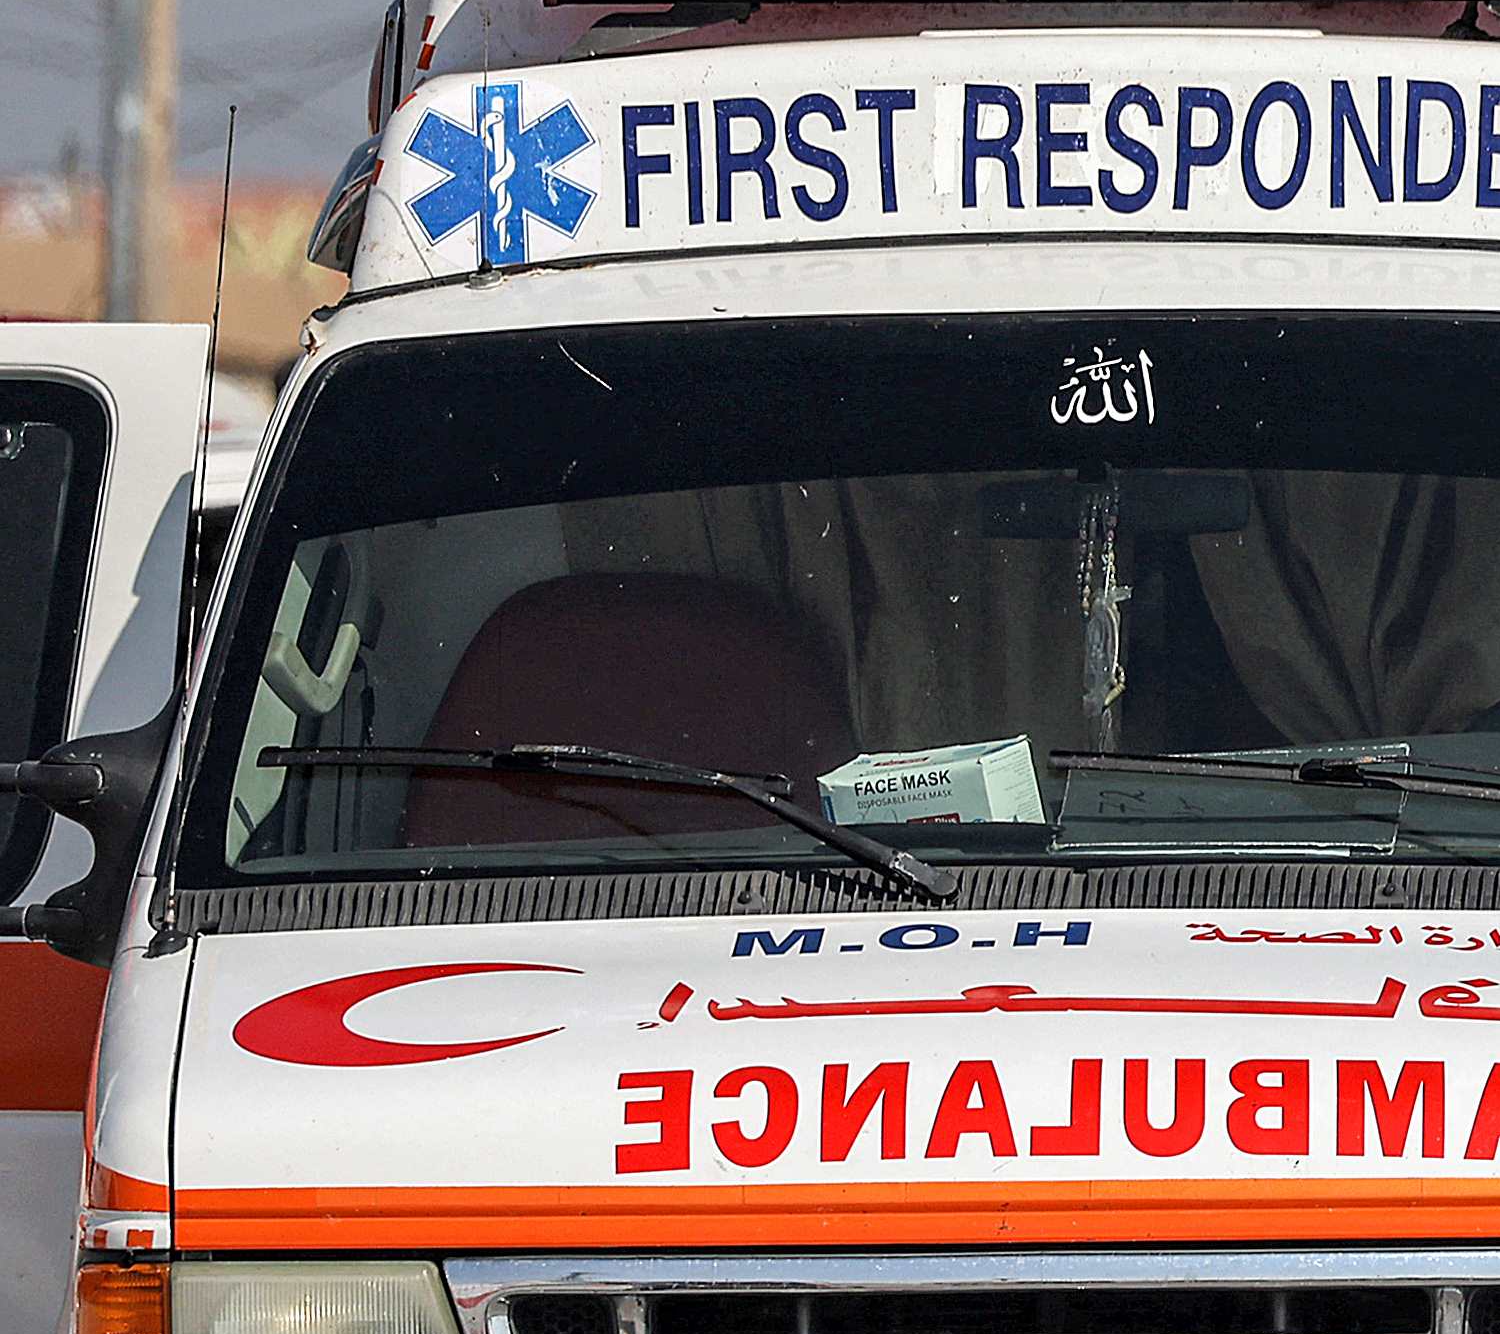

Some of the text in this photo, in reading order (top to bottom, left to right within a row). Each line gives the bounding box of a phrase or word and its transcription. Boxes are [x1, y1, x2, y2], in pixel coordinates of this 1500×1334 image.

[622, 88, 916, 228] FIRST
[854, 770, 951, 796] FACE MASK
[857, 789, 953, 810] DISPOSABLE FACE MASK
[1186, 923, 1403, 945] الصحة
